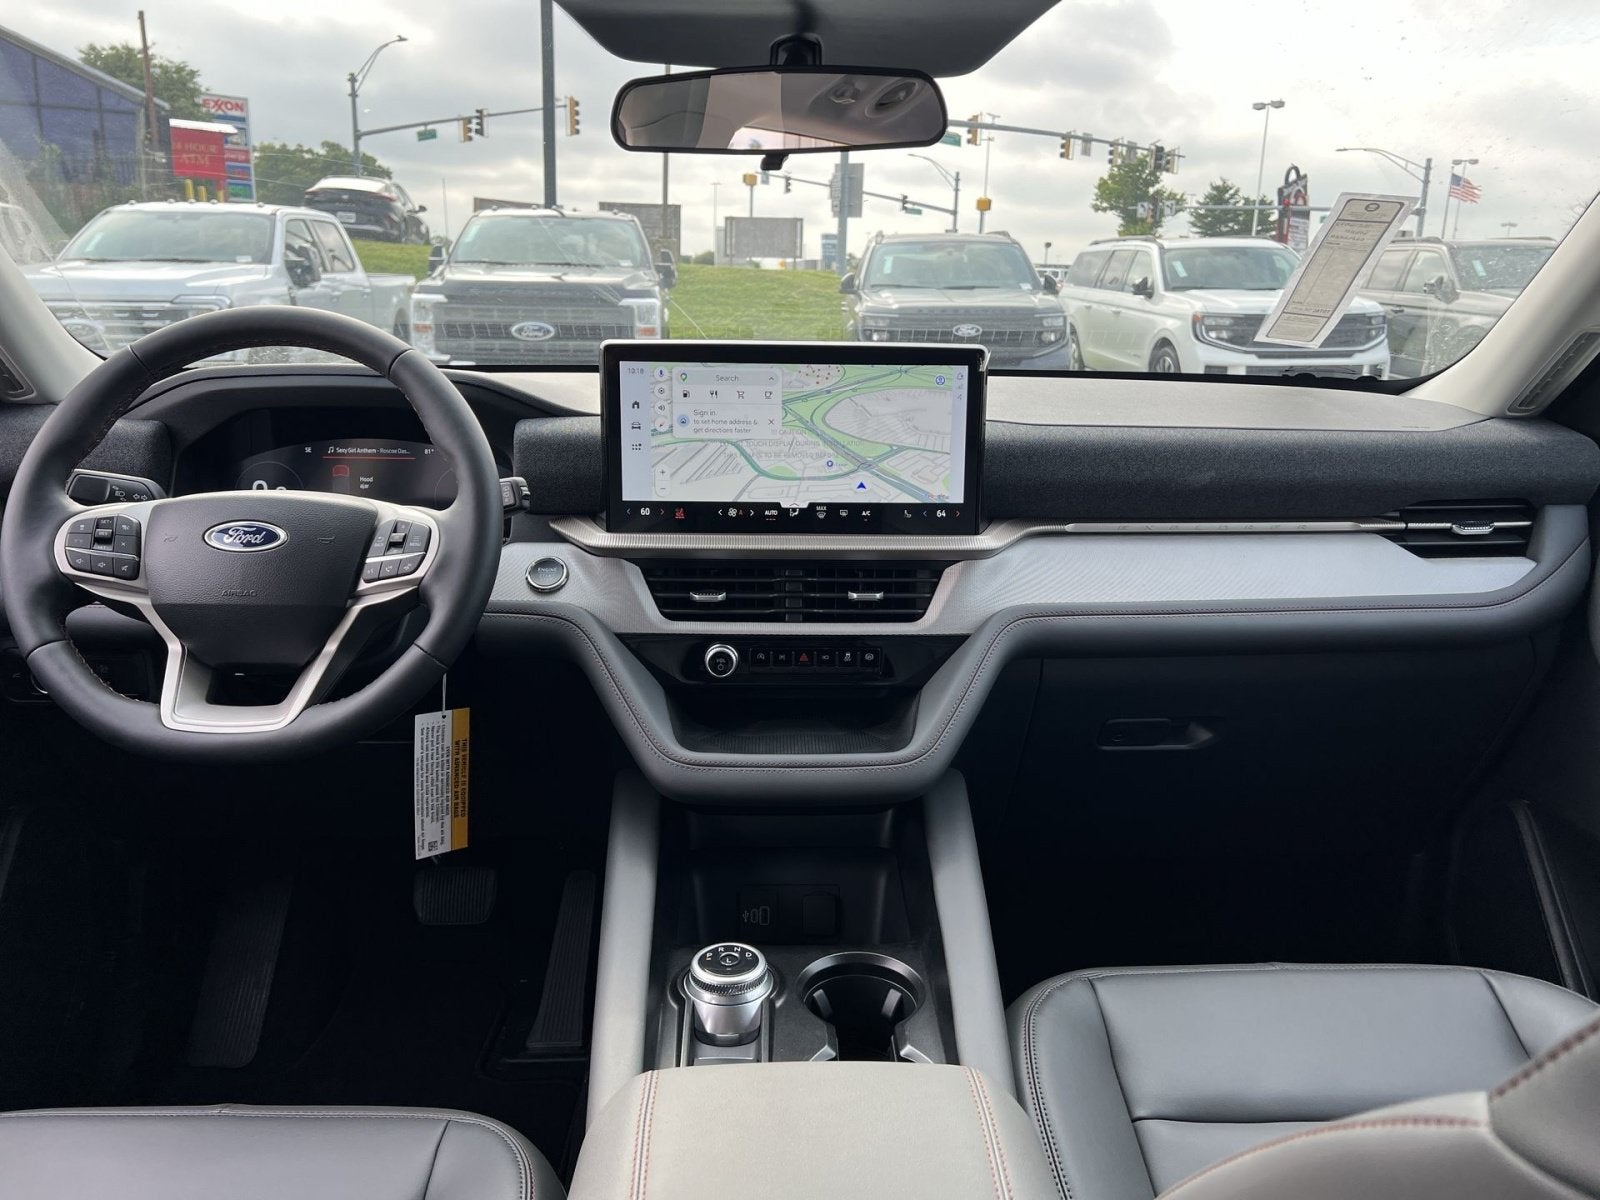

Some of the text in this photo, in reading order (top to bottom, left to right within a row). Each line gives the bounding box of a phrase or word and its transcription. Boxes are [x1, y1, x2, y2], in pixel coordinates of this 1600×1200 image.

[202, 99, 244, 112] EXXON
[715, 374, 739, 382] Search
[693, 409, 709, 417] Sign
[640, 508, 650, 516] 60
[936, 510, 946, 518] 64
[223, 526, 266, 544] Ford
